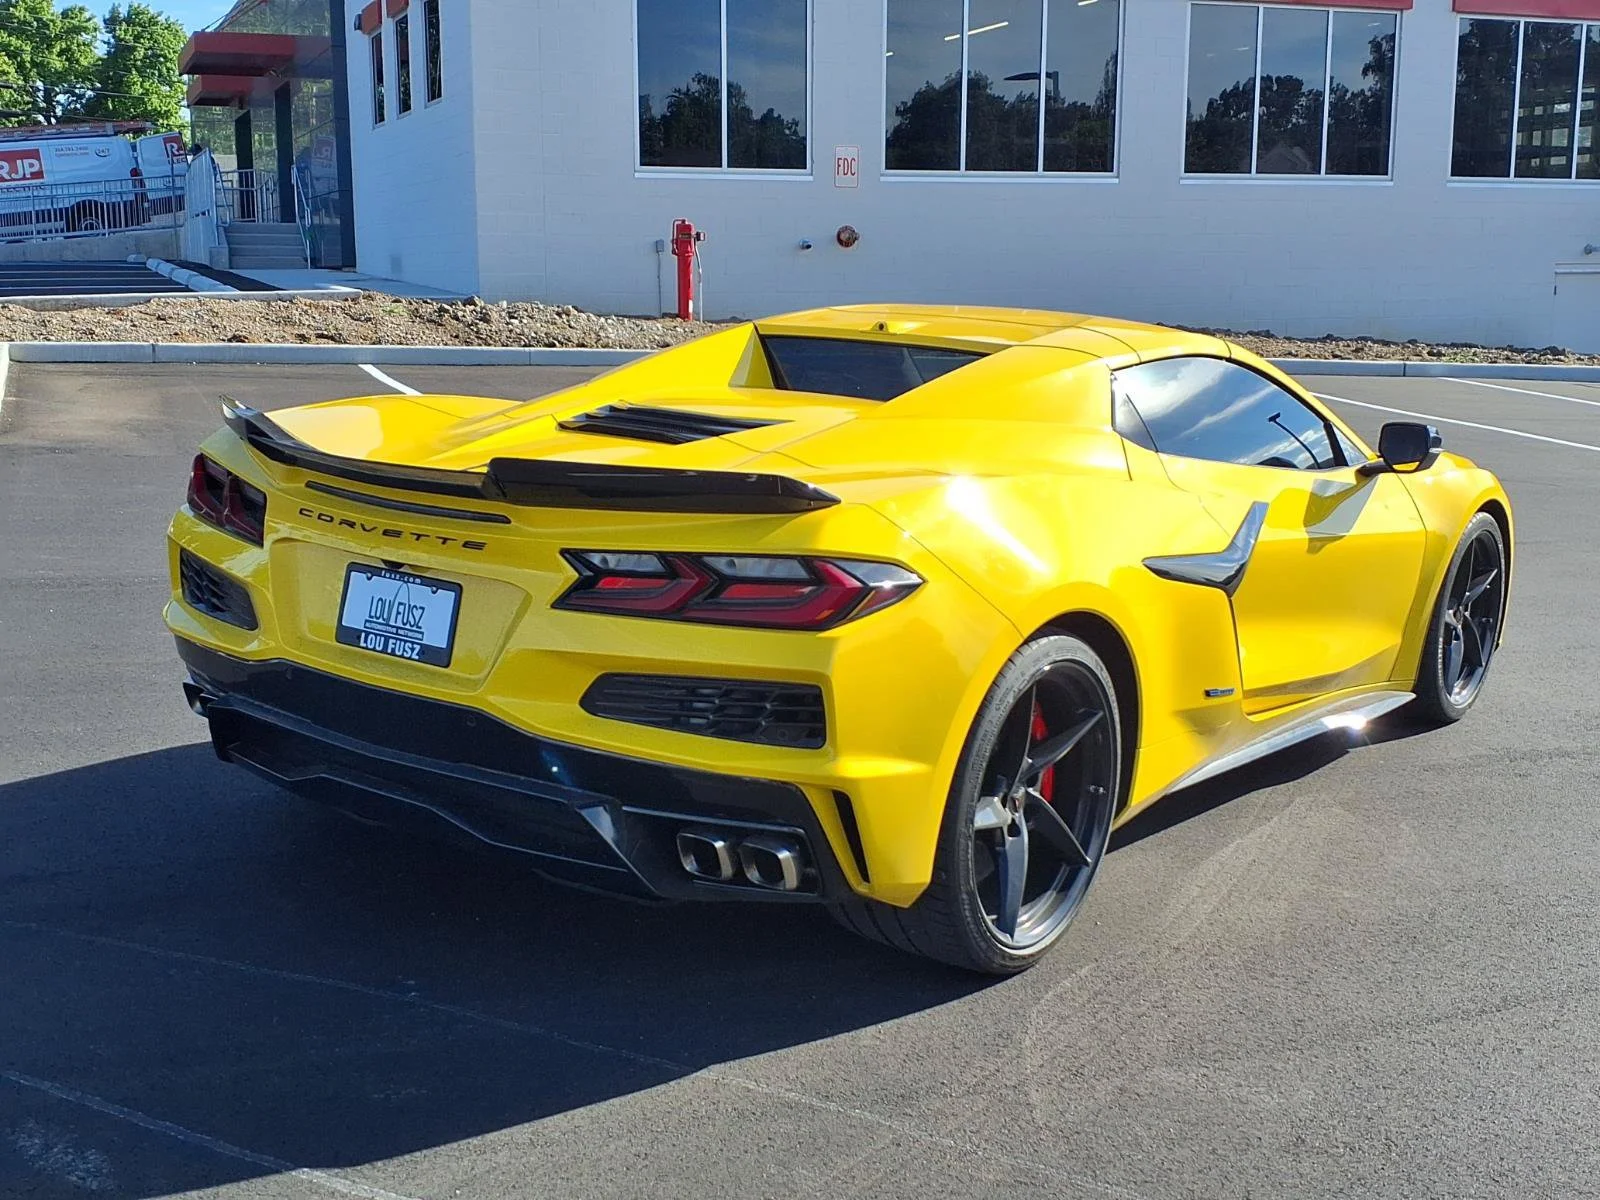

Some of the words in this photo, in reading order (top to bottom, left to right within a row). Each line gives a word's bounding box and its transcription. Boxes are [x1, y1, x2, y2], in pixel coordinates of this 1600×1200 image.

[837, 157, 856, 176] FDC
[298, 507, 487, 551] CORVETTE
[381, 570, 422, 584] fusz.com
[368, 595, 391, 621] LOU
[394, 602, 426, 629] FUSZ
[360, 631, 385, 651] LOU
[387, 638, 421, 660] FUSZ
